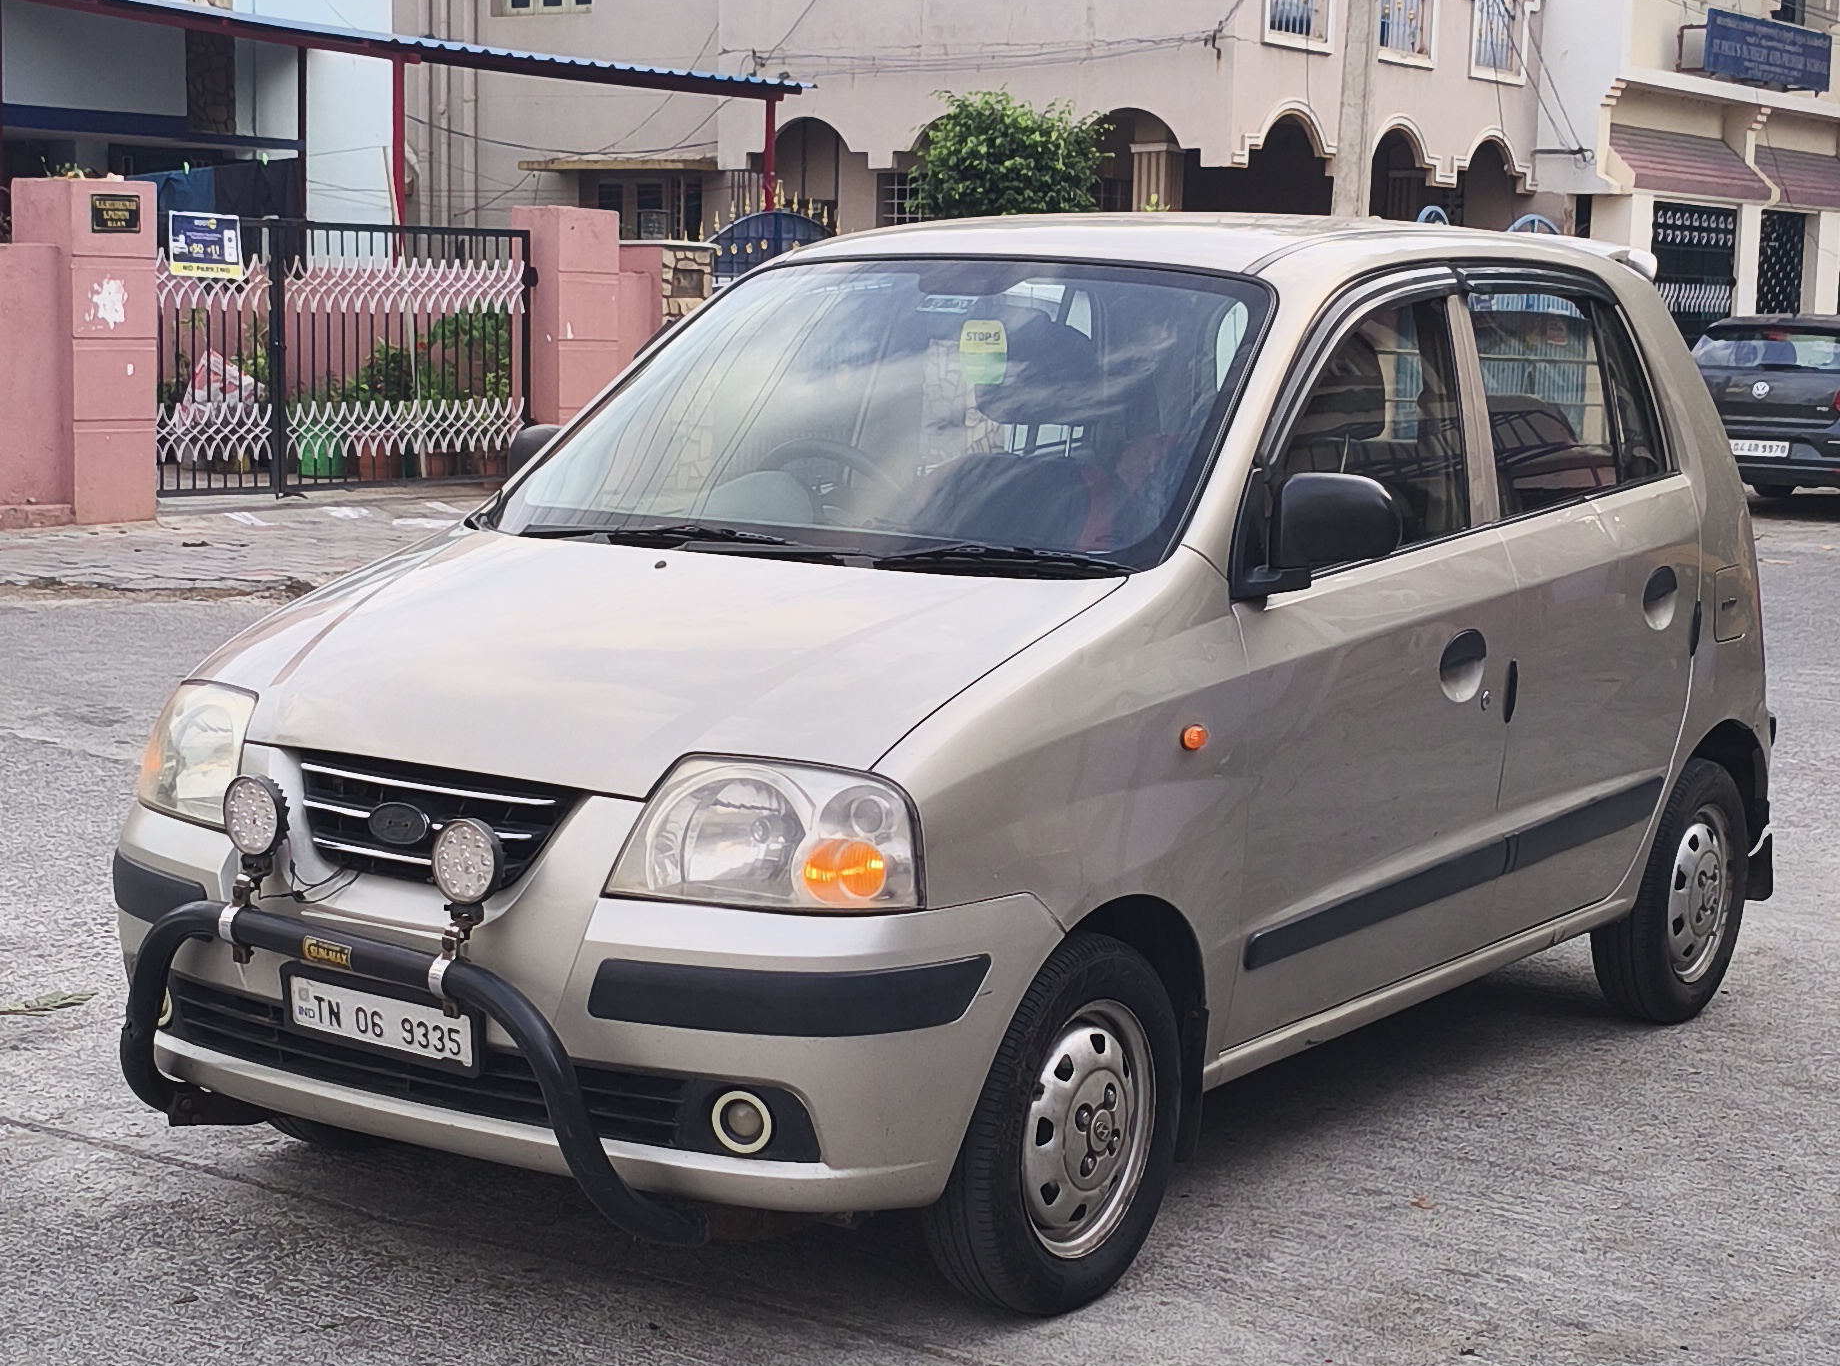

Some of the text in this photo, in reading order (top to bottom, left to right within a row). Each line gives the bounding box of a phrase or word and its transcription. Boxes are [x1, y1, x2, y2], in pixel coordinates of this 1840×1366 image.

[196, 265, 231, 274] PARKING
[298, 1005, 316, 1019] IND
[313, 995, 461, 1056] TN 06 9335
